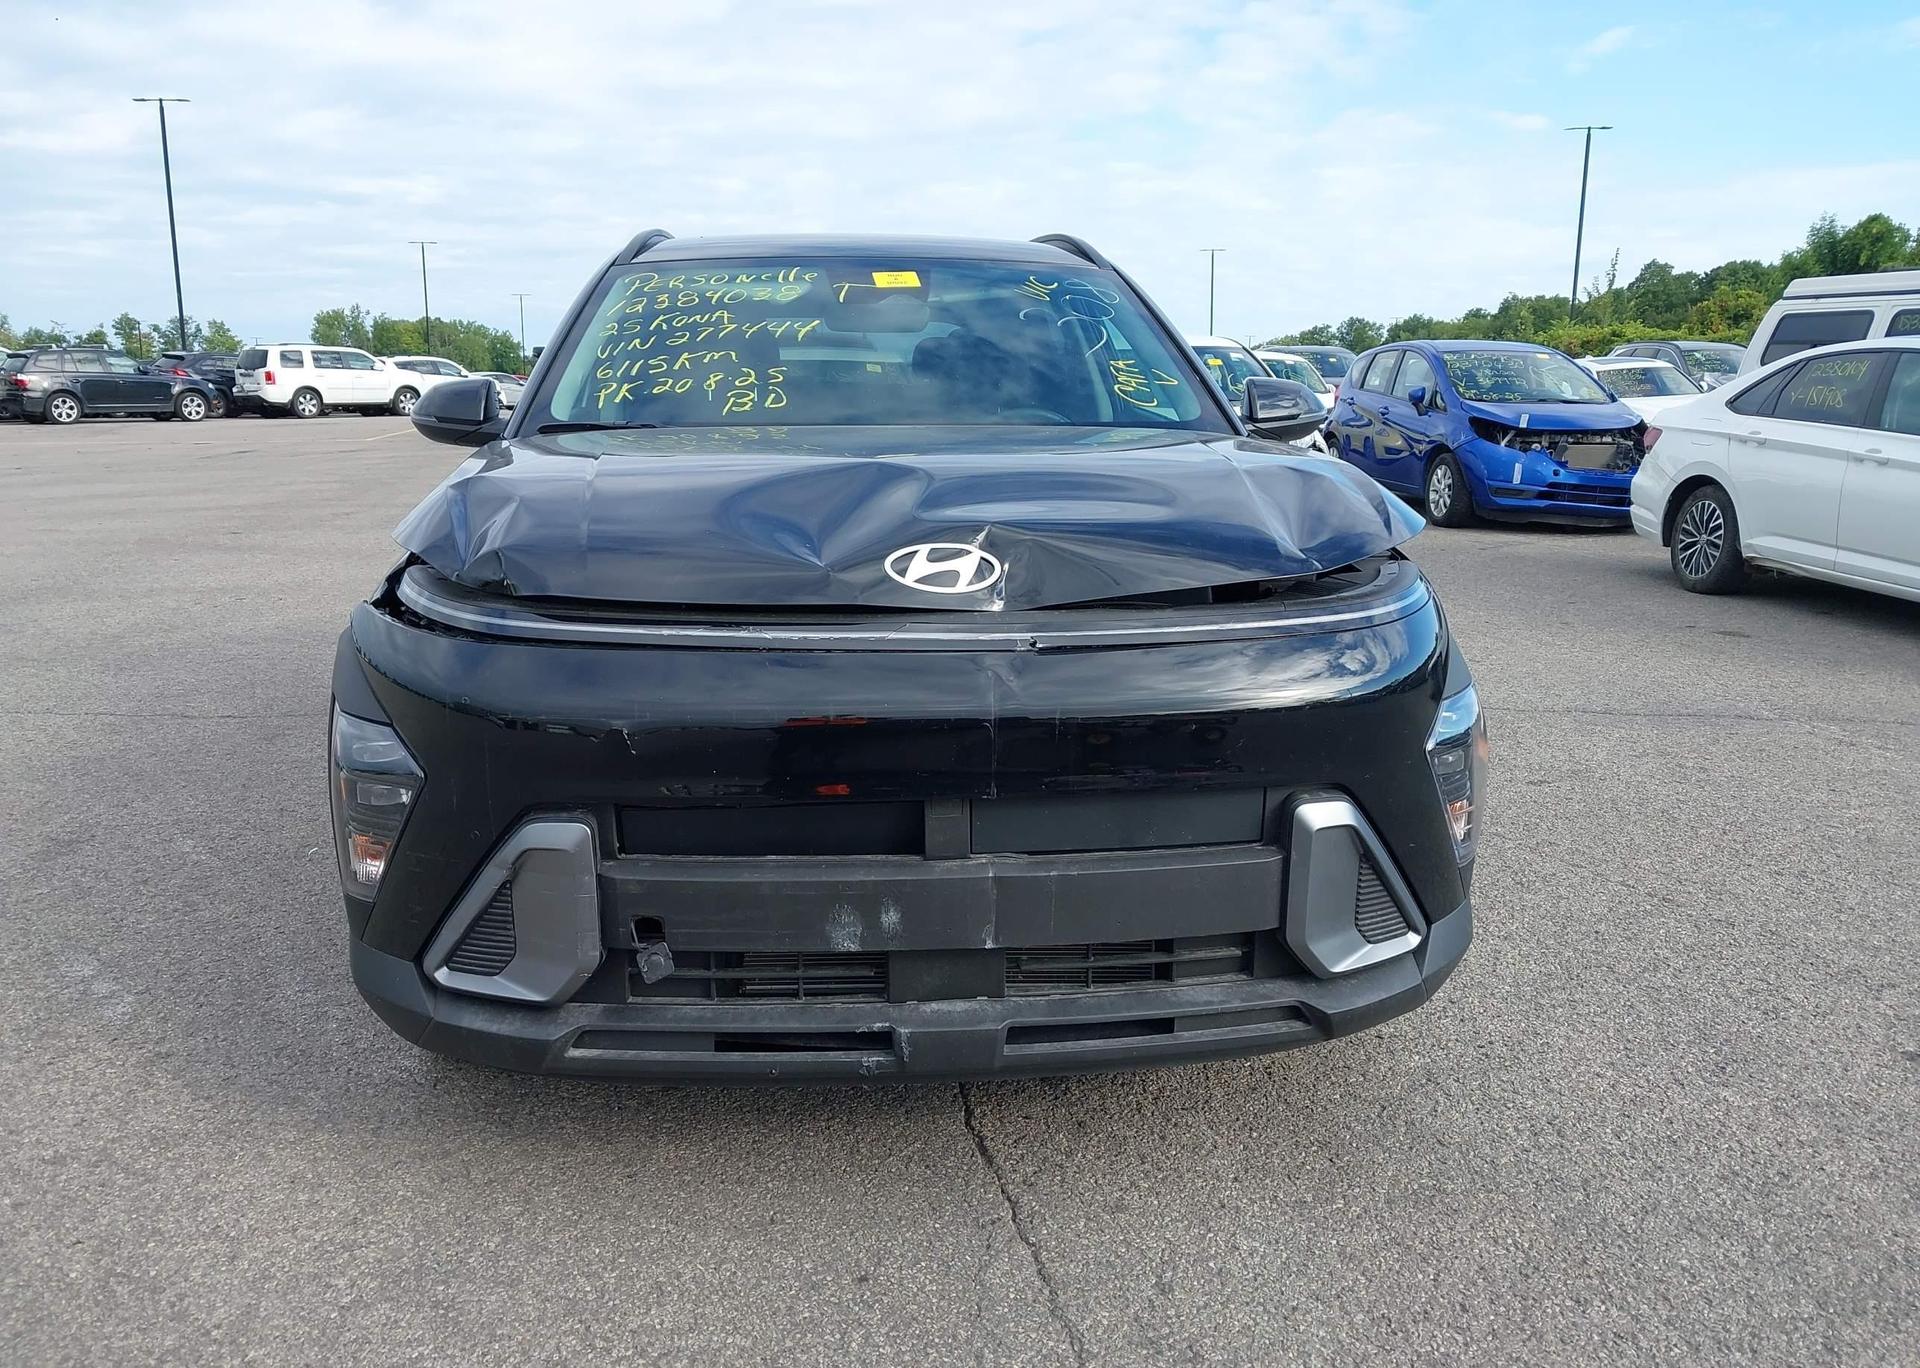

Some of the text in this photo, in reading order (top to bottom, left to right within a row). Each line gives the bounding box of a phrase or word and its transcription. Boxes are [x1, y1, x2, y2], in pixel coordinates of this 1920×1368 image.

[599, 310, 736, 336] 25 KONA
[597, 320, 822, 359] VIN 277444
